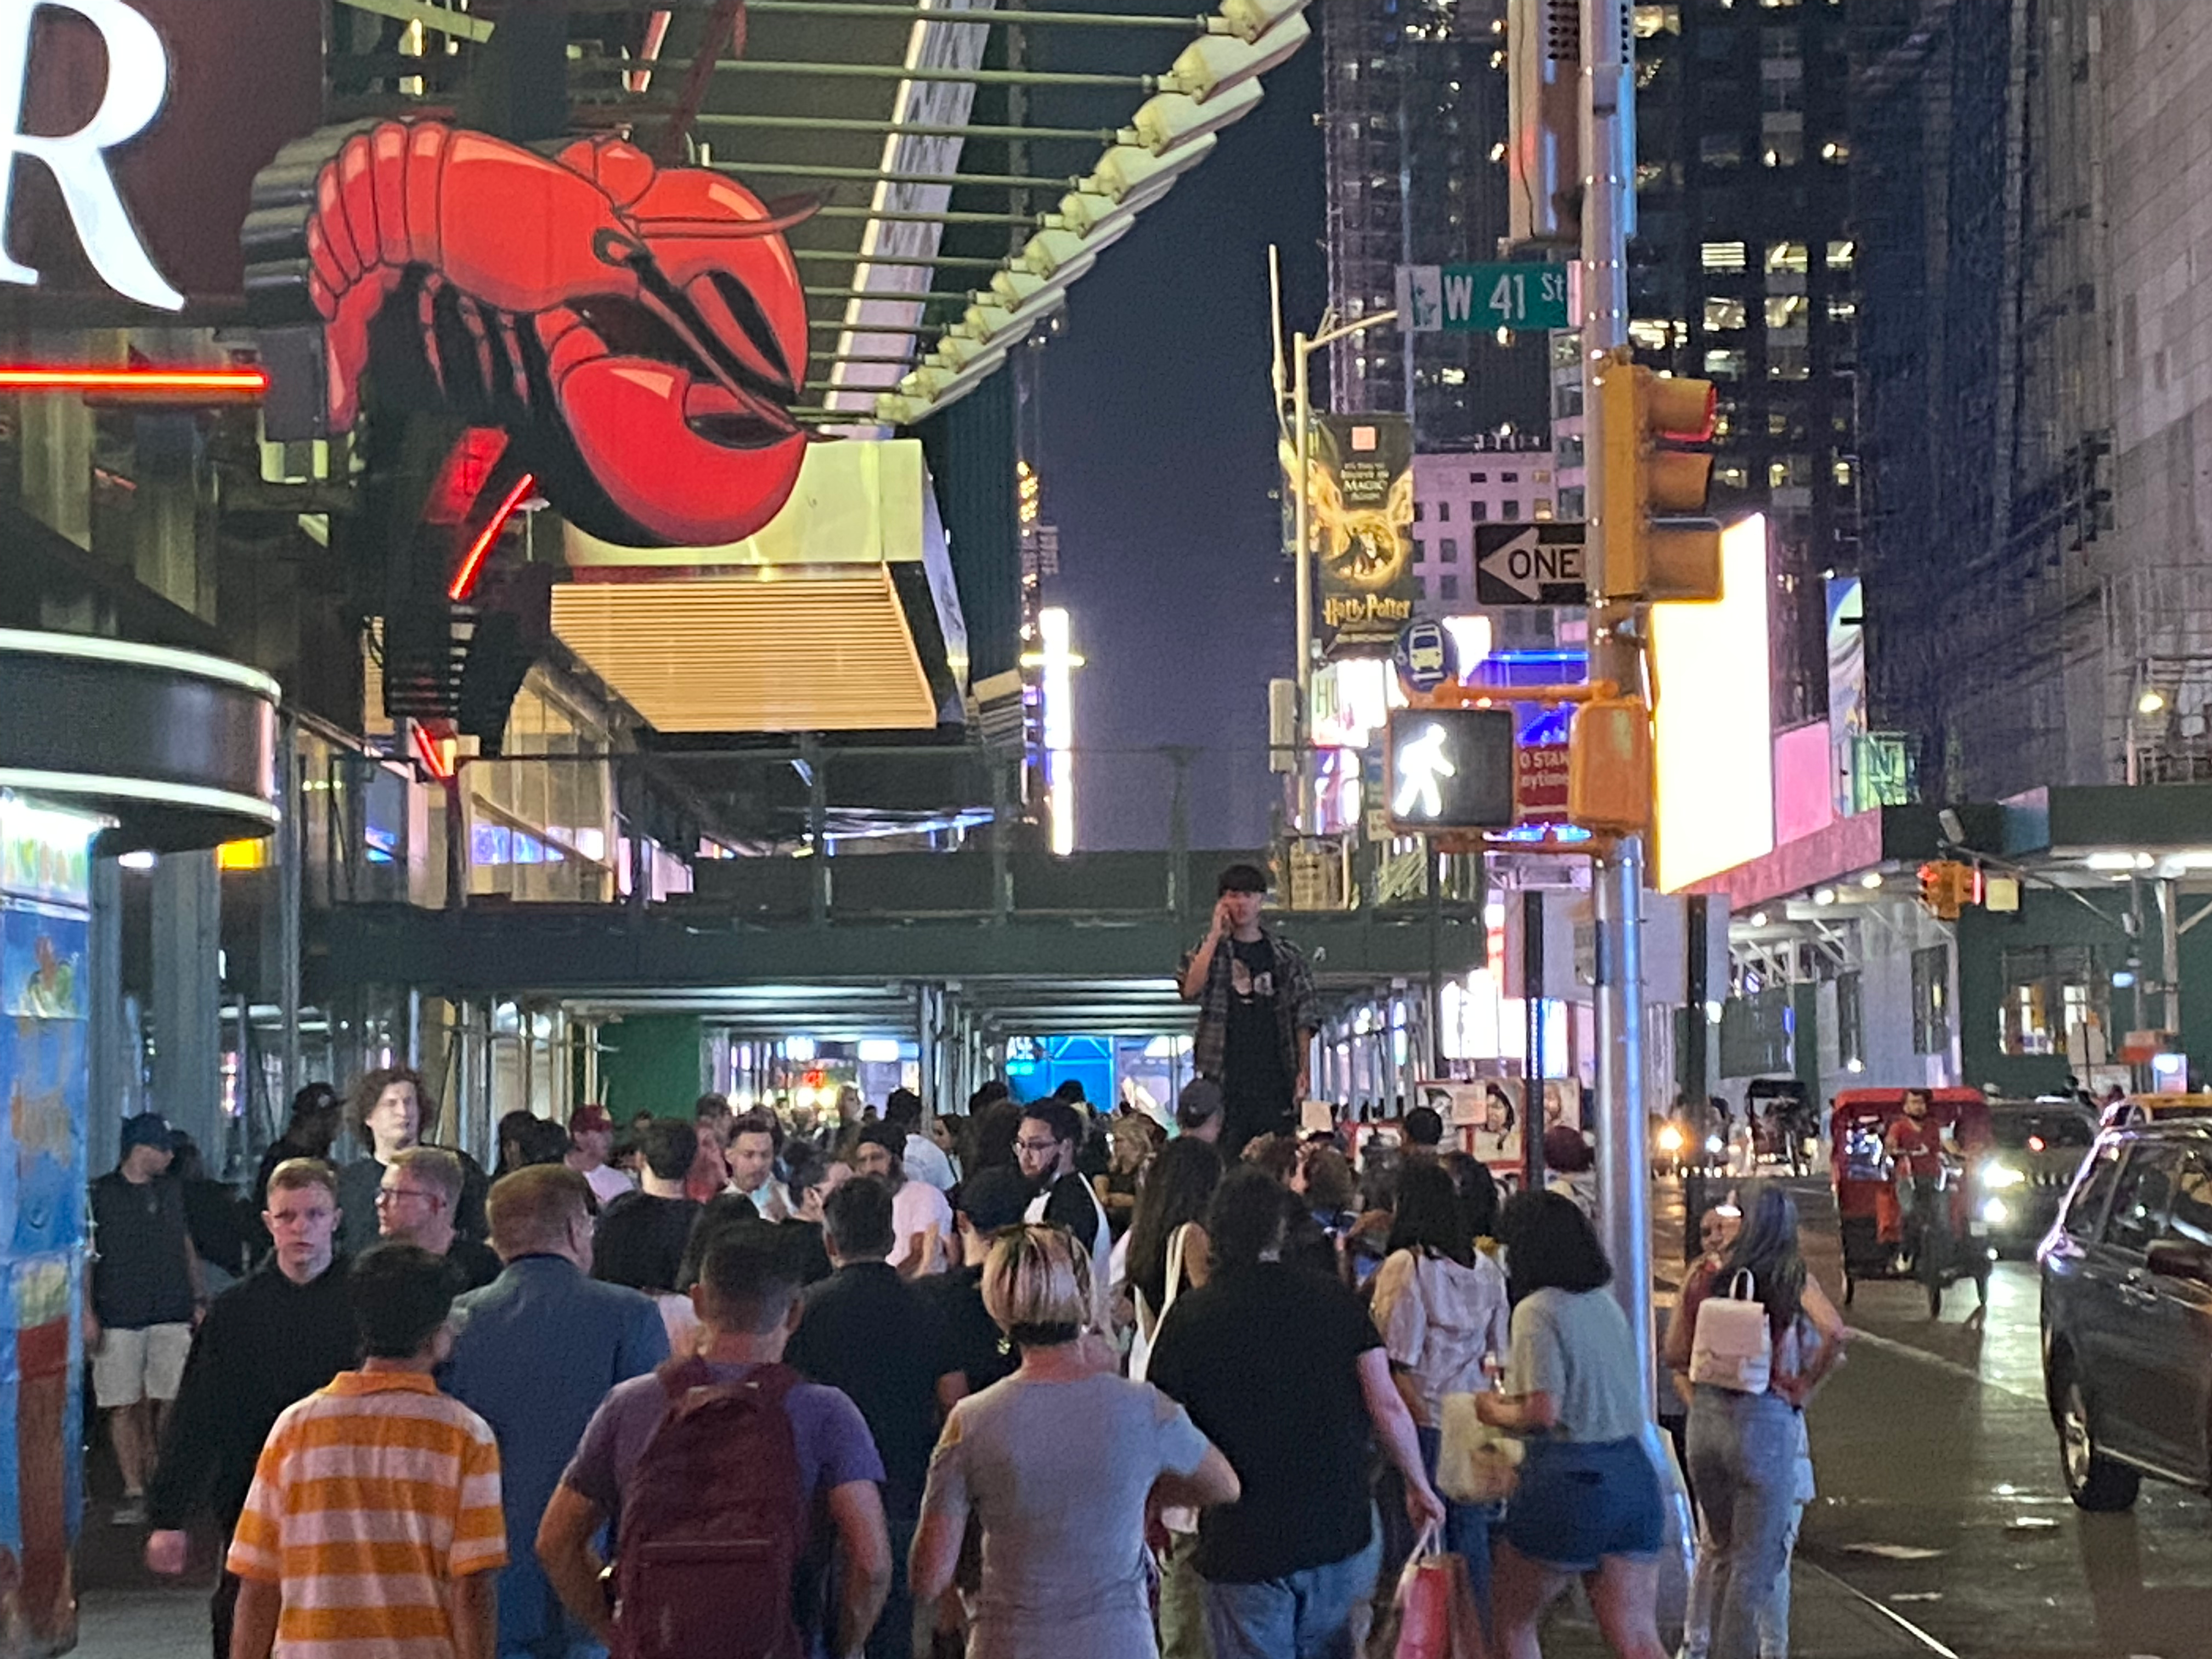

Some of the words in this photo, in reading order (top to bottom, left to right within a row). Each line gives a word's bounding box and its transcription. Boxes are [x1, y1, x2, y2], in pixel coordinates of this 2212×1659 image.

[0, 0, 185, 312] R
[1444, 275, 1473, 321] W
[1488, 274, 1526, 320] 41
[1541, 272, 1565, 302] St
[1509, 549, 1582, 579] ONE
[1322, 597, 1365, 627] Harry
[1365, 592, 1410, 622] Potter
[1533, 750, 1570, 769] STAN
